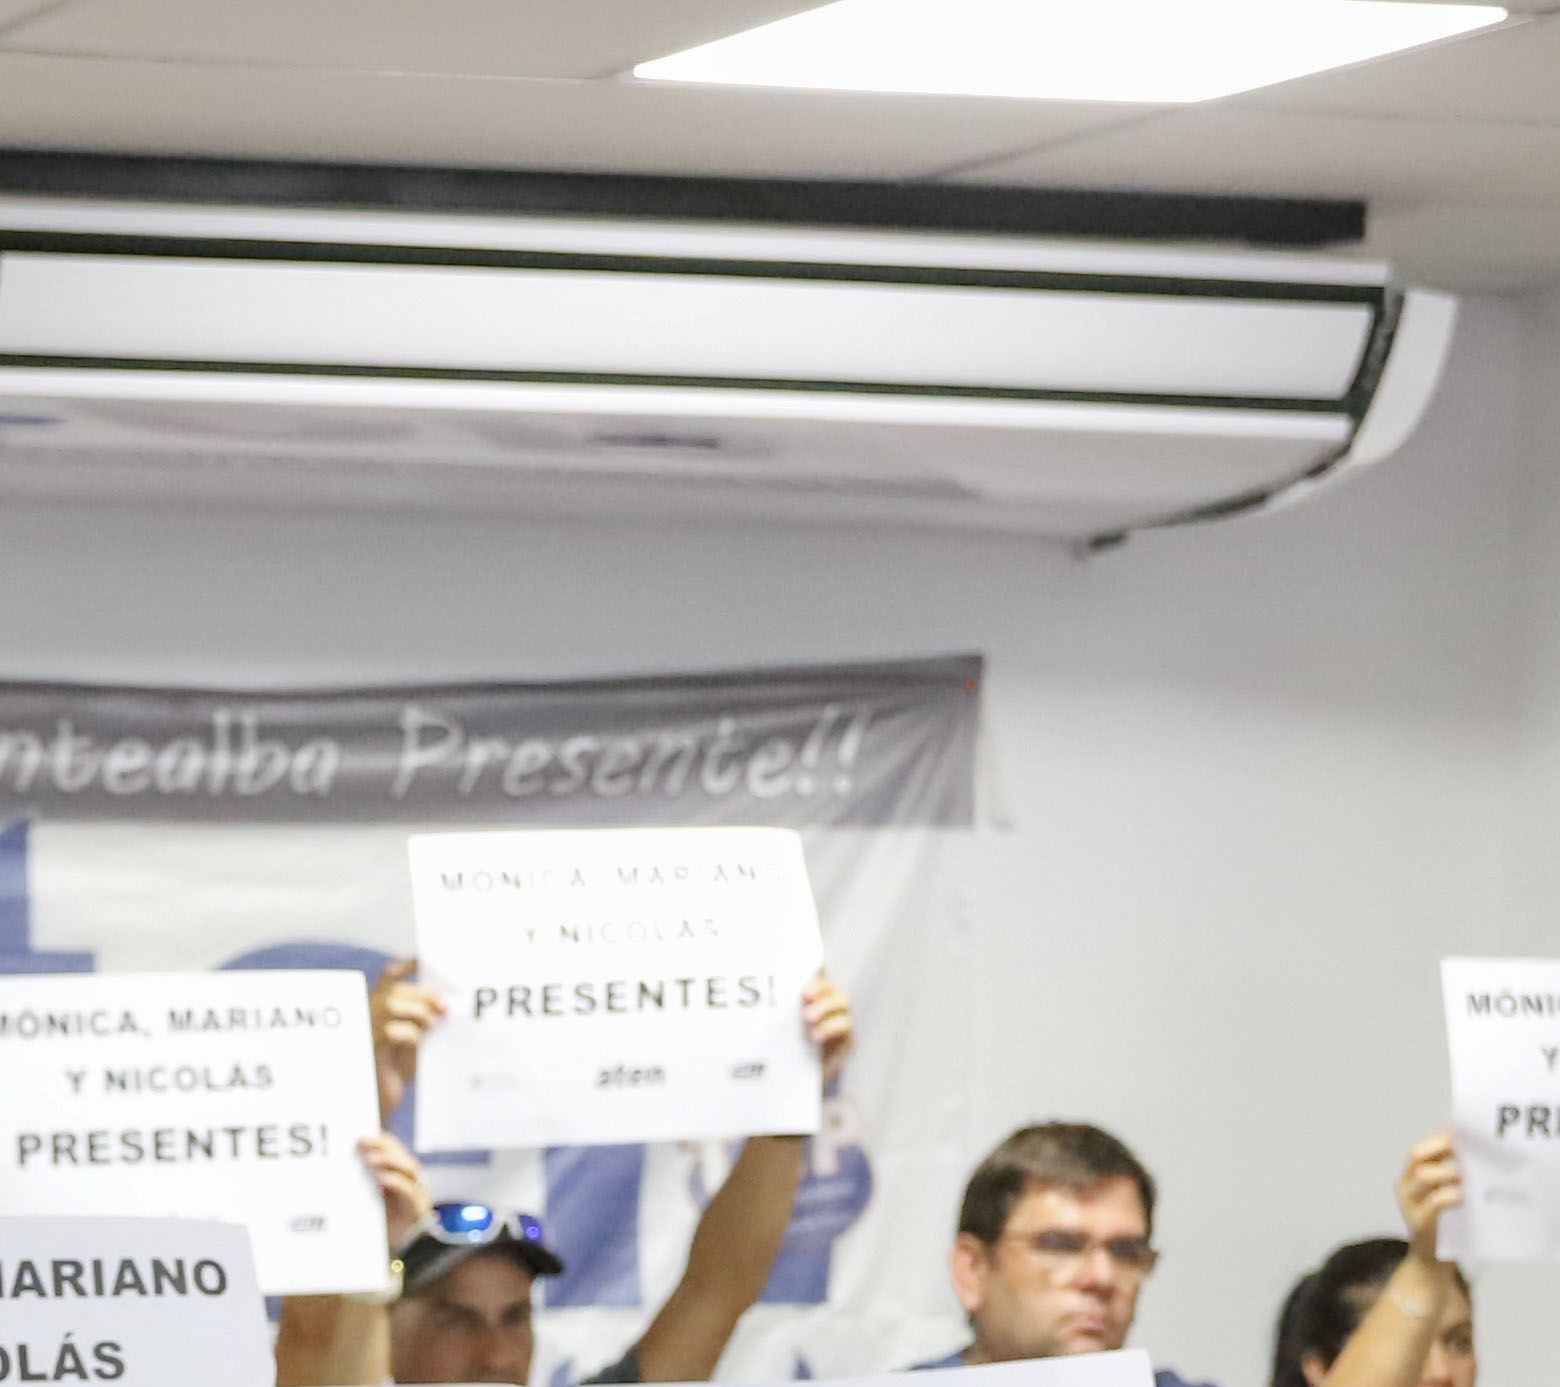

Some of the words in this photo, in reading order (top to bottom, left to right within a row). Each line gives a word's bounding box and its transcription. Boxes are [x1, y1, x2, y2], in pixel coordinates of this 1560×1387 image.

[391, 707, 880, 800] Presente!!
[523, 924, 538, 945] Y
[472, 977, 772, 1021] PRESENTES!
[167, 1007, 339, 1032] MARIANO
[1541, 1046, 1560, 1072] Y
[65, 1070, 86, 1095] Y
[104, 1064, 274, 1093] NICOLÁS
[596, 1064, 665, 1088] aten
[17, 1125, 326, 1168] PRESENTES!
